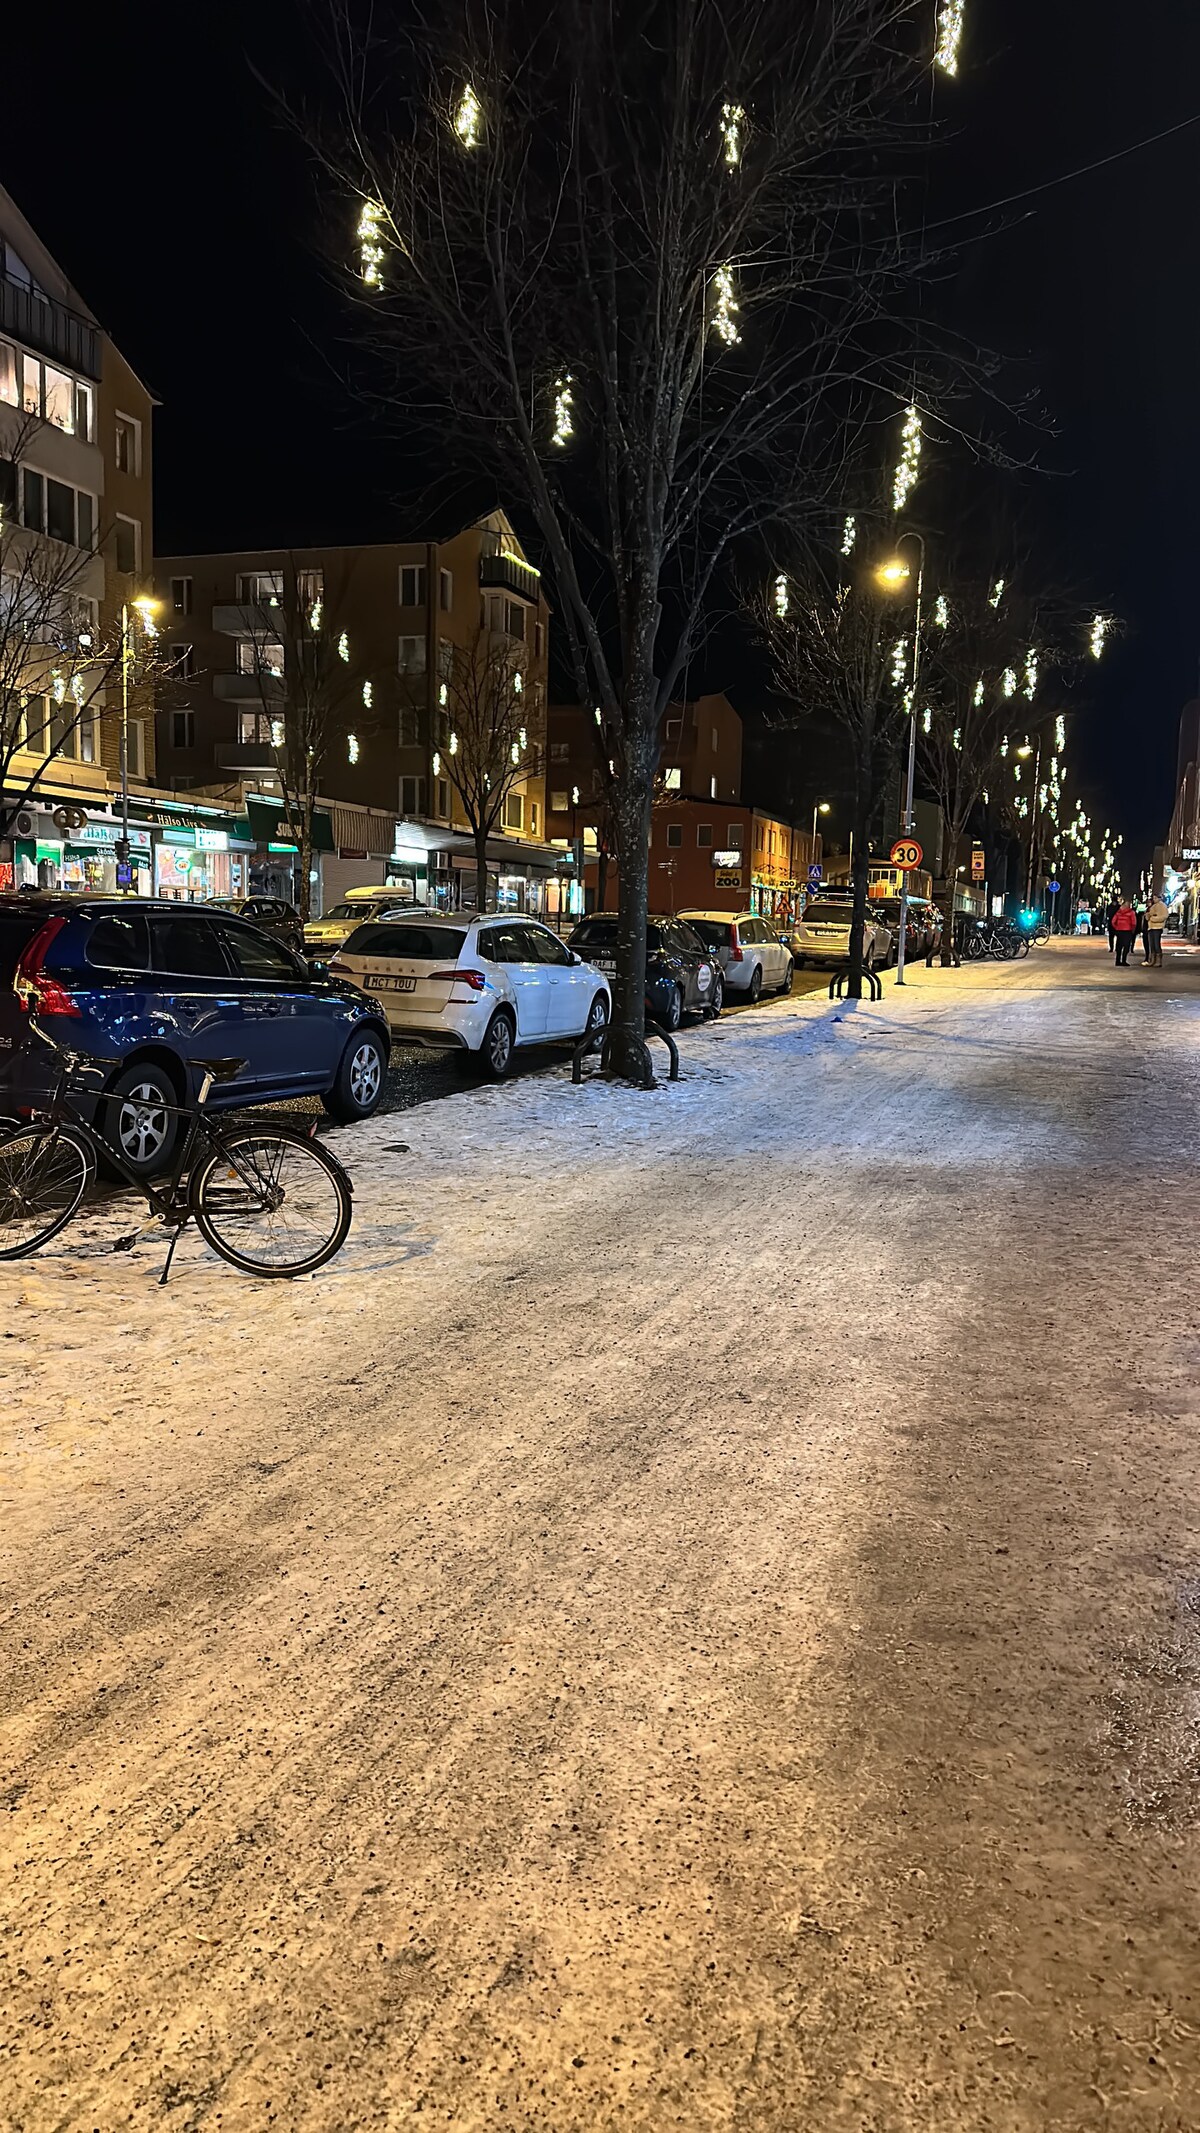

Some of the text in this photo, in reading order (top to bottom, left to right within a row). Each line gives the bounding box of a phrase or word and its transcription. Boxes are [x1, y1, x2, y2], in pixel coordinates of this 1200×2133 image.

[157, 814, 181, 827] Hälso
[896, 847, 918, 863] 30
[371, 977, 390, 988] MCT
